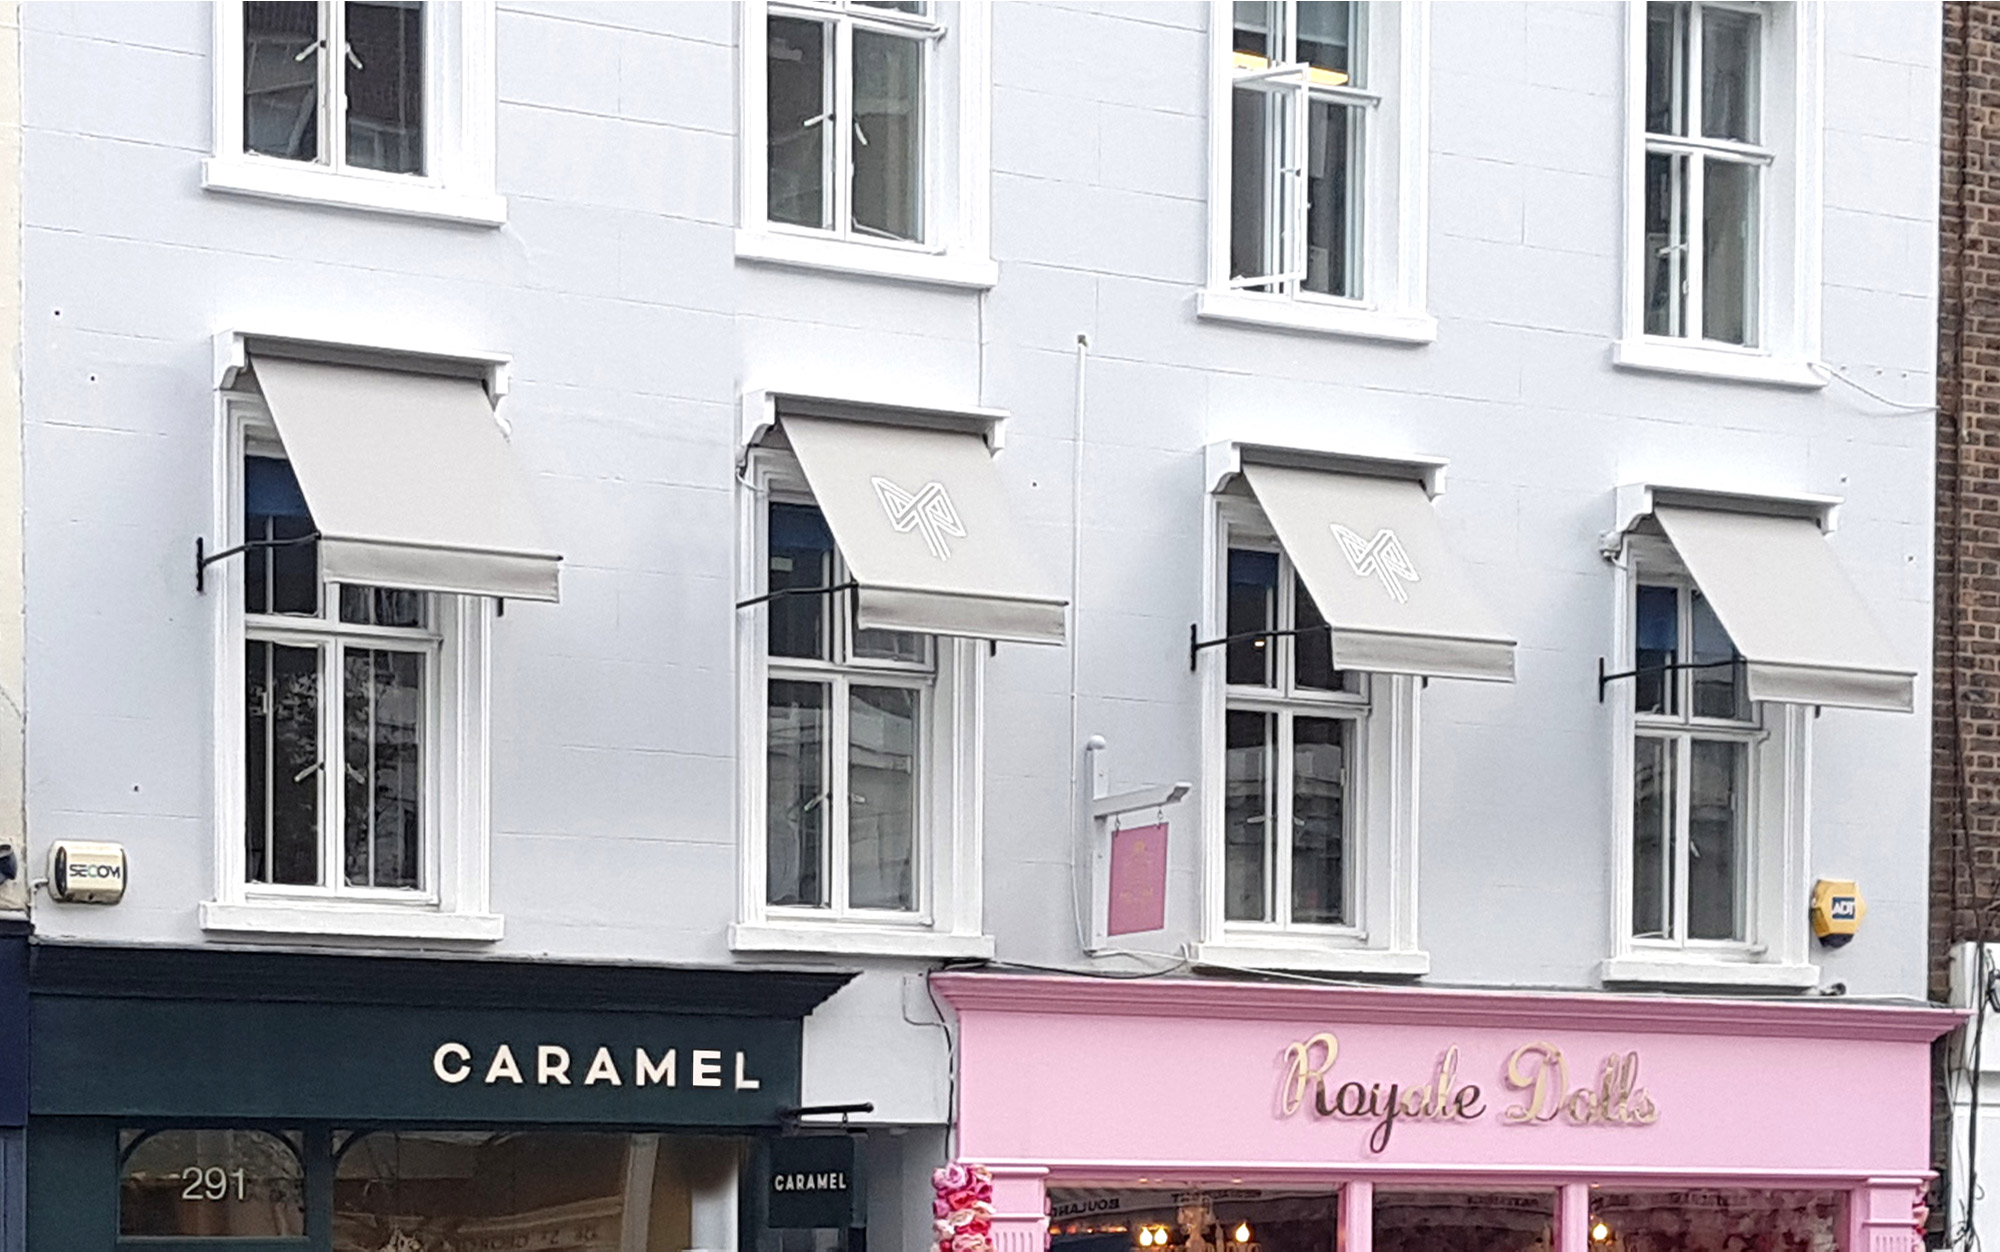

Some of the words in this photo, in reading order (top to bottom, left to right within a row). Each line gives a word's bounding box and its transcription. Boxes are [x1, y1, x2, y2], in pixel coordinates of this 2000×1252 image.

[69, 863, 121, 879] SECOM
[1832, 900, 1855, 916] ADT
[432, 1041, 762, 1091] CARAMEL
[1283, 1031, 1487, 1154] Royale
[1504, 1040, 1660, 1125] Dolls
[182, 1166, 244, 1200] 291
[774, 1172, 847, 1192] CARAMEL
